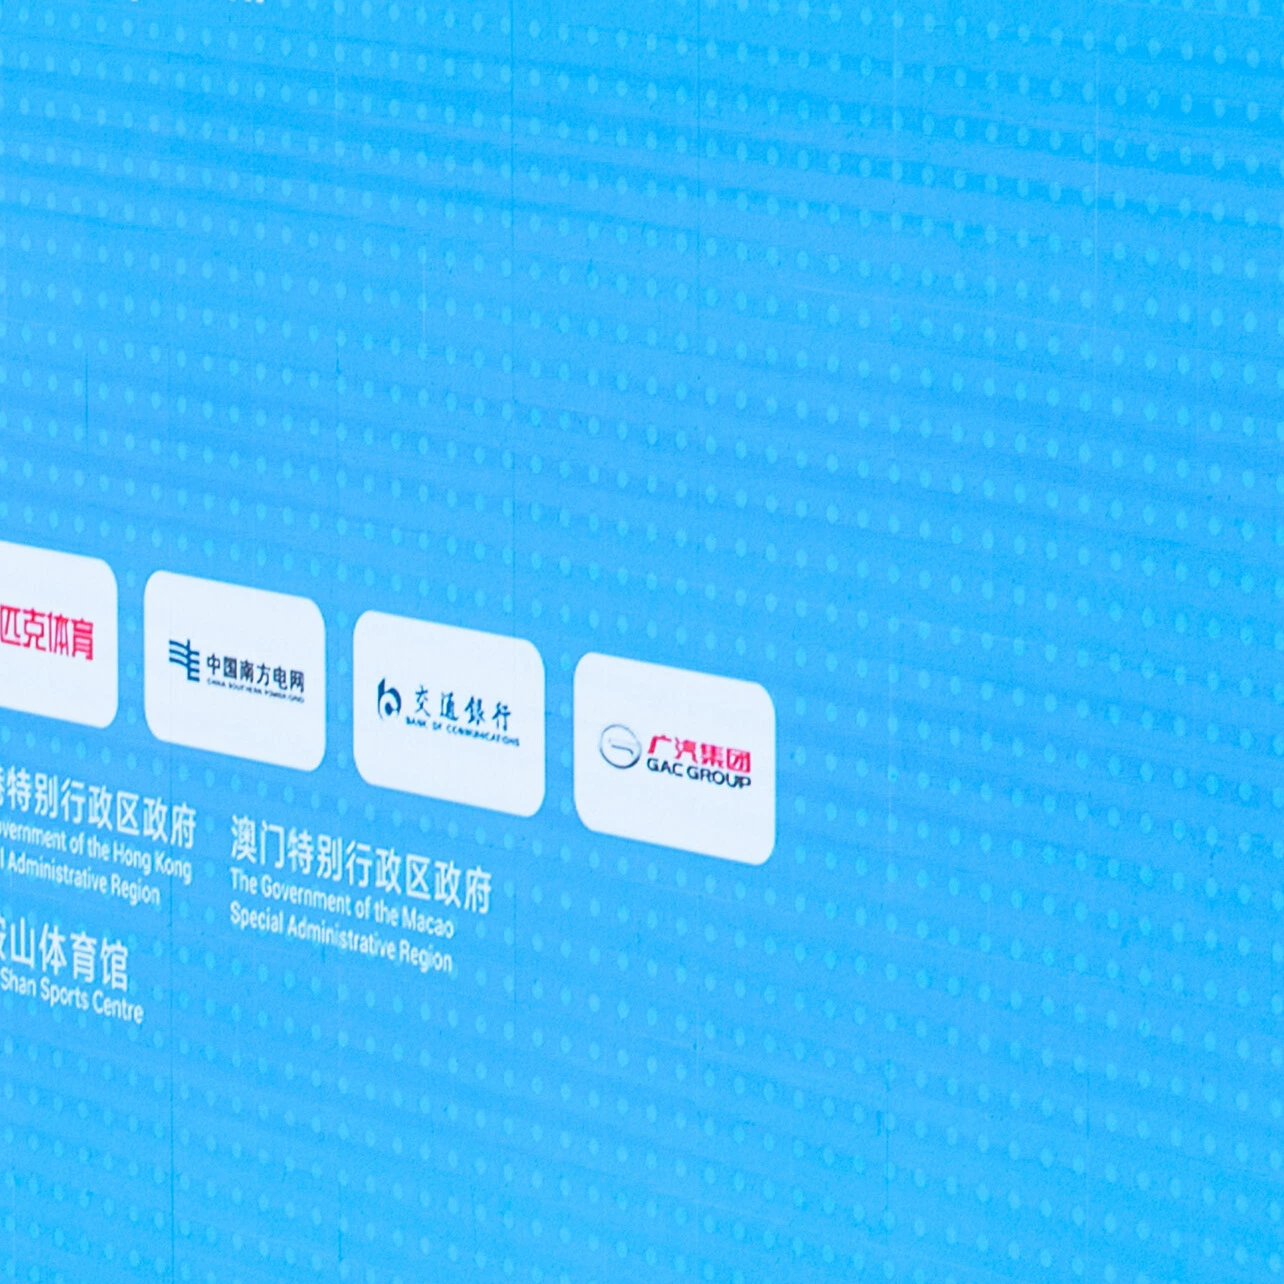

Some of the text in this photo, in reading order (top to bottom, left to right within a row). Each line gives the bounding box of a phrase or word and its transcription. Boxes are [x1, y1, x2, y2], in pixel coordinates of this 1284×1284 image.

[0, 604, 94, 660] 匹克体育
[206, 653, 305, 693] 中国南方电网
[415, 684, 511, 732] 交通银行
[647, 734, 751, 774] 广汽集团
[647, 757, 751, 789] GAC GROUP
[6, 850, 107, 894] Administrative
[110, 872, 160, 906] Region
[68, 831, 84, 855] of
[86, 834, 110, 861] the
[112, 840, 151, 876] Hong
[154, 850, 191, 885] Kong
[230, 814, 491, 914] 澳门特别行政区政府
[229, 866, 454, 938] The Government of the Macao
[229, 900, 452, 972] Special Administrative Region
[0, 966, 36, 996] Shan
[40, 976, 88, 1010] Sports
[92, 989, 143, 1024] Centre
